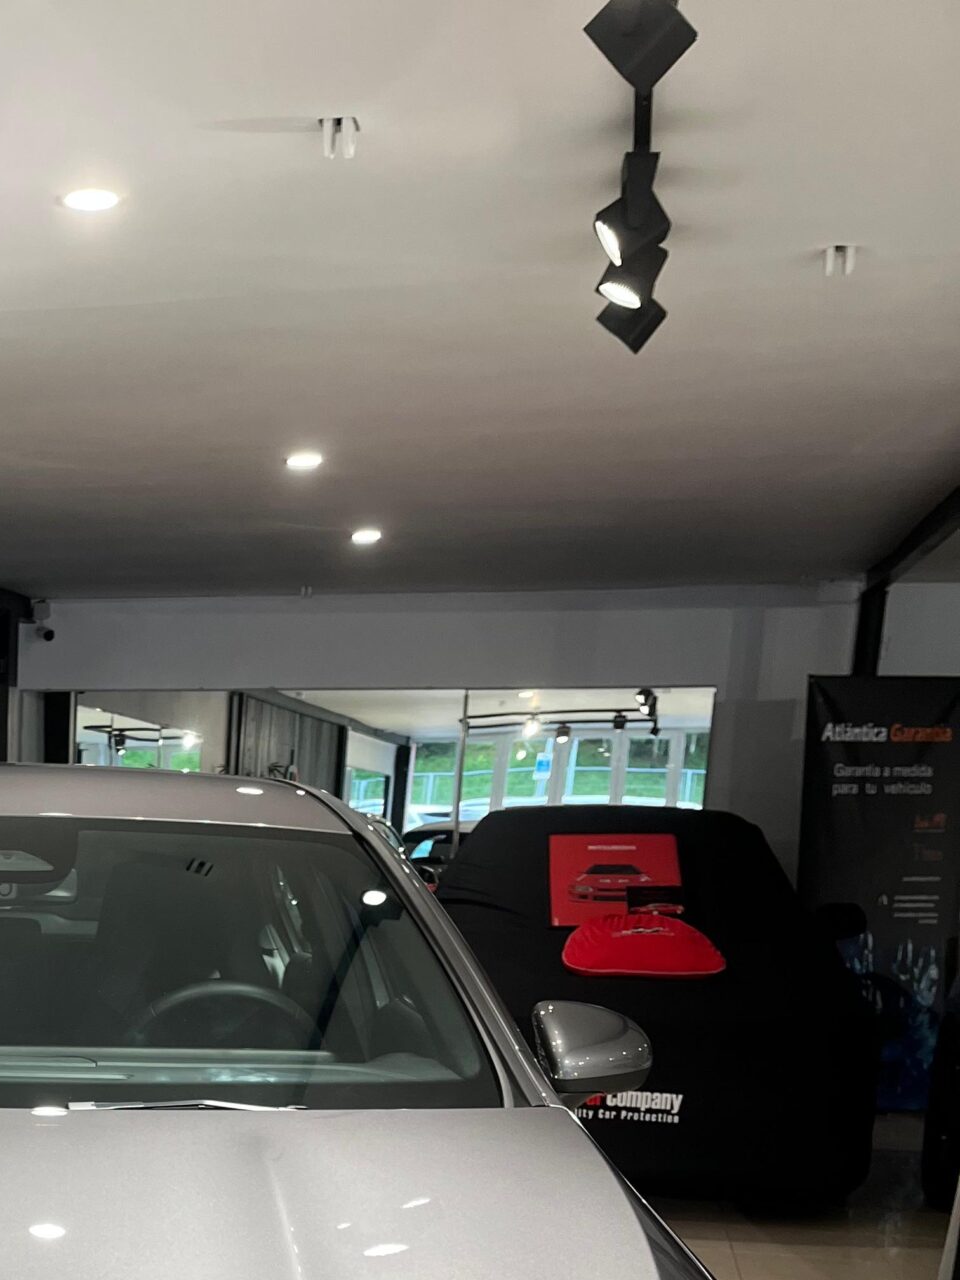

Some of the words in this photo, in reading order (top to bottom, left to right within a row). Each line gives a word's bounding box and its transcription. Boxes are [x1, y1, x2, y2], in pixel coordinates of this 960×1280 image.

[832, 783, 859, 796] para
[598, 1108, 617, 1119] Car
[620, 1110, 680, 1123] Protection
